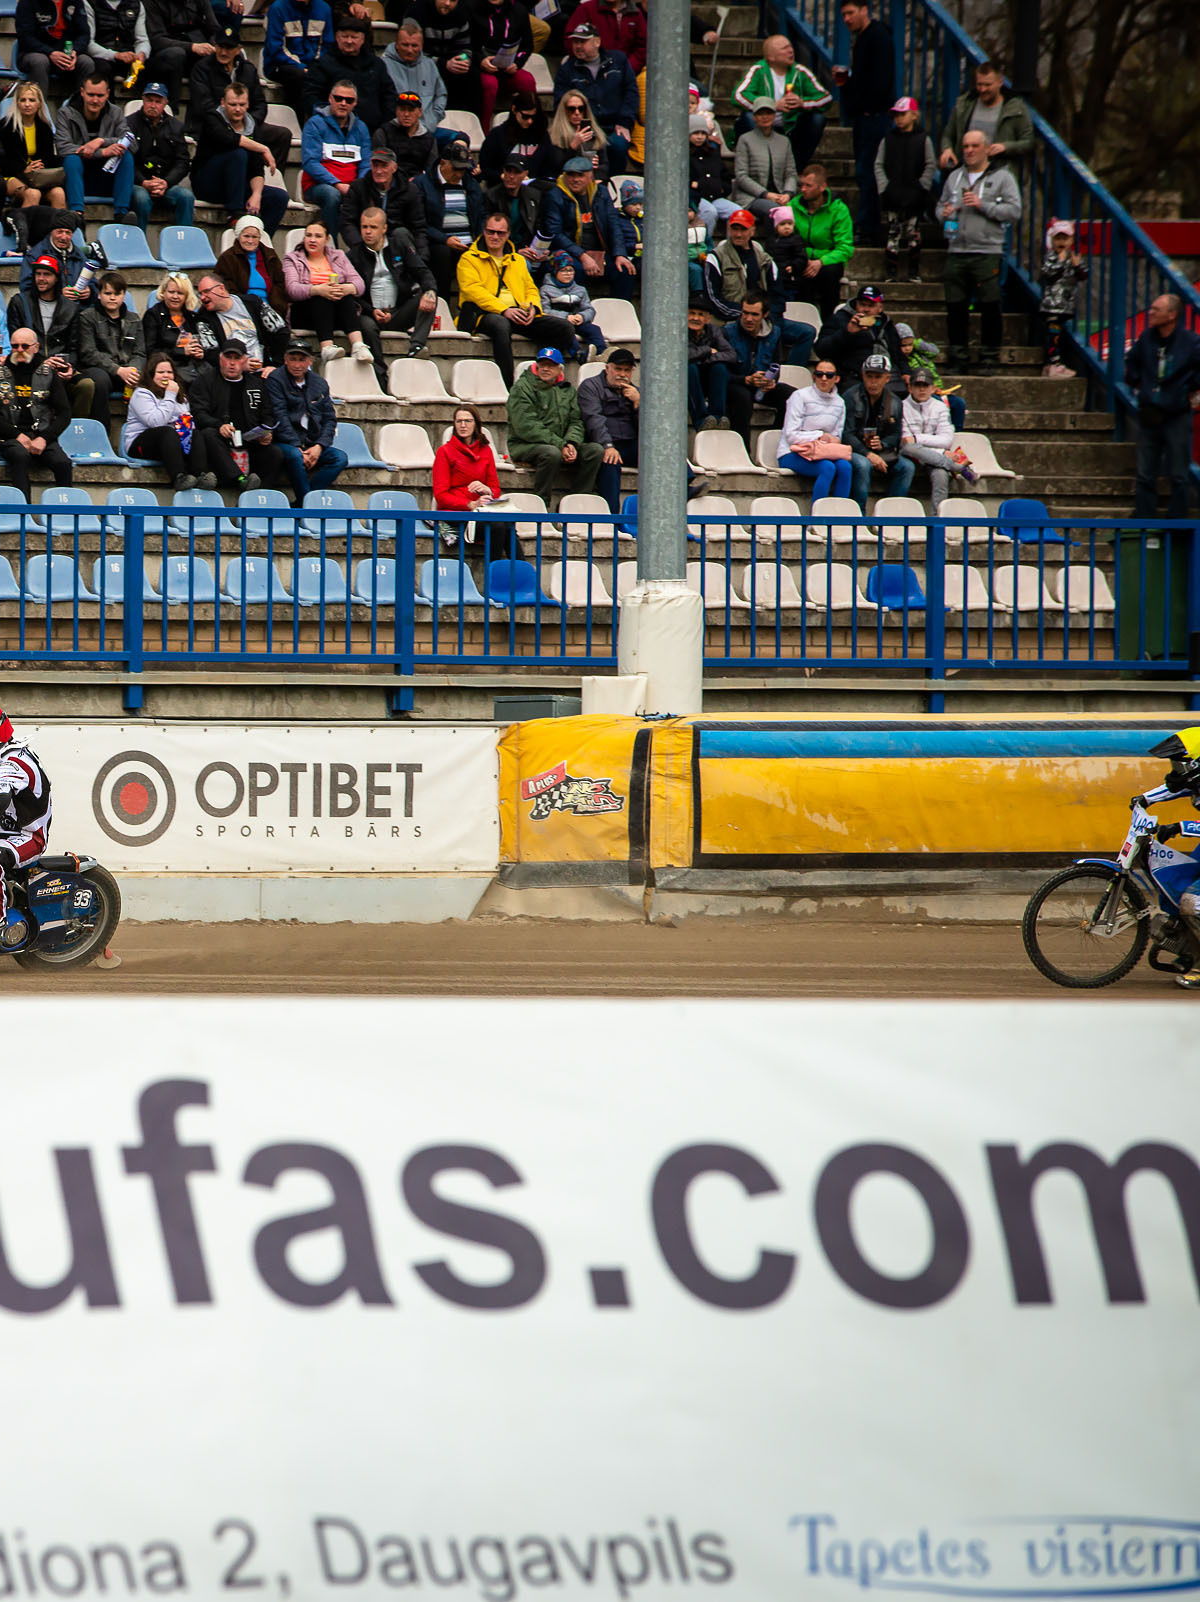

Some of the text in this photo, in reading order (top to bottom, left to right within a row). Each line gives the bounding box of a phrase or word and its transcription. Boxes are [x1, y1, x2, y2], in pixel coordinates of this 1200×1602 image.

[195, 761, 423, 818] OPTIBET
[196, 822, 423, 838] SPORTA BĀRS
[73, 889, 93, 908] 33
[212, 1517, 292, 1600] 2,
[312, 1514, 737, 1602] Daugavpils
[787, 1512, 993, 1590] Tapetes
